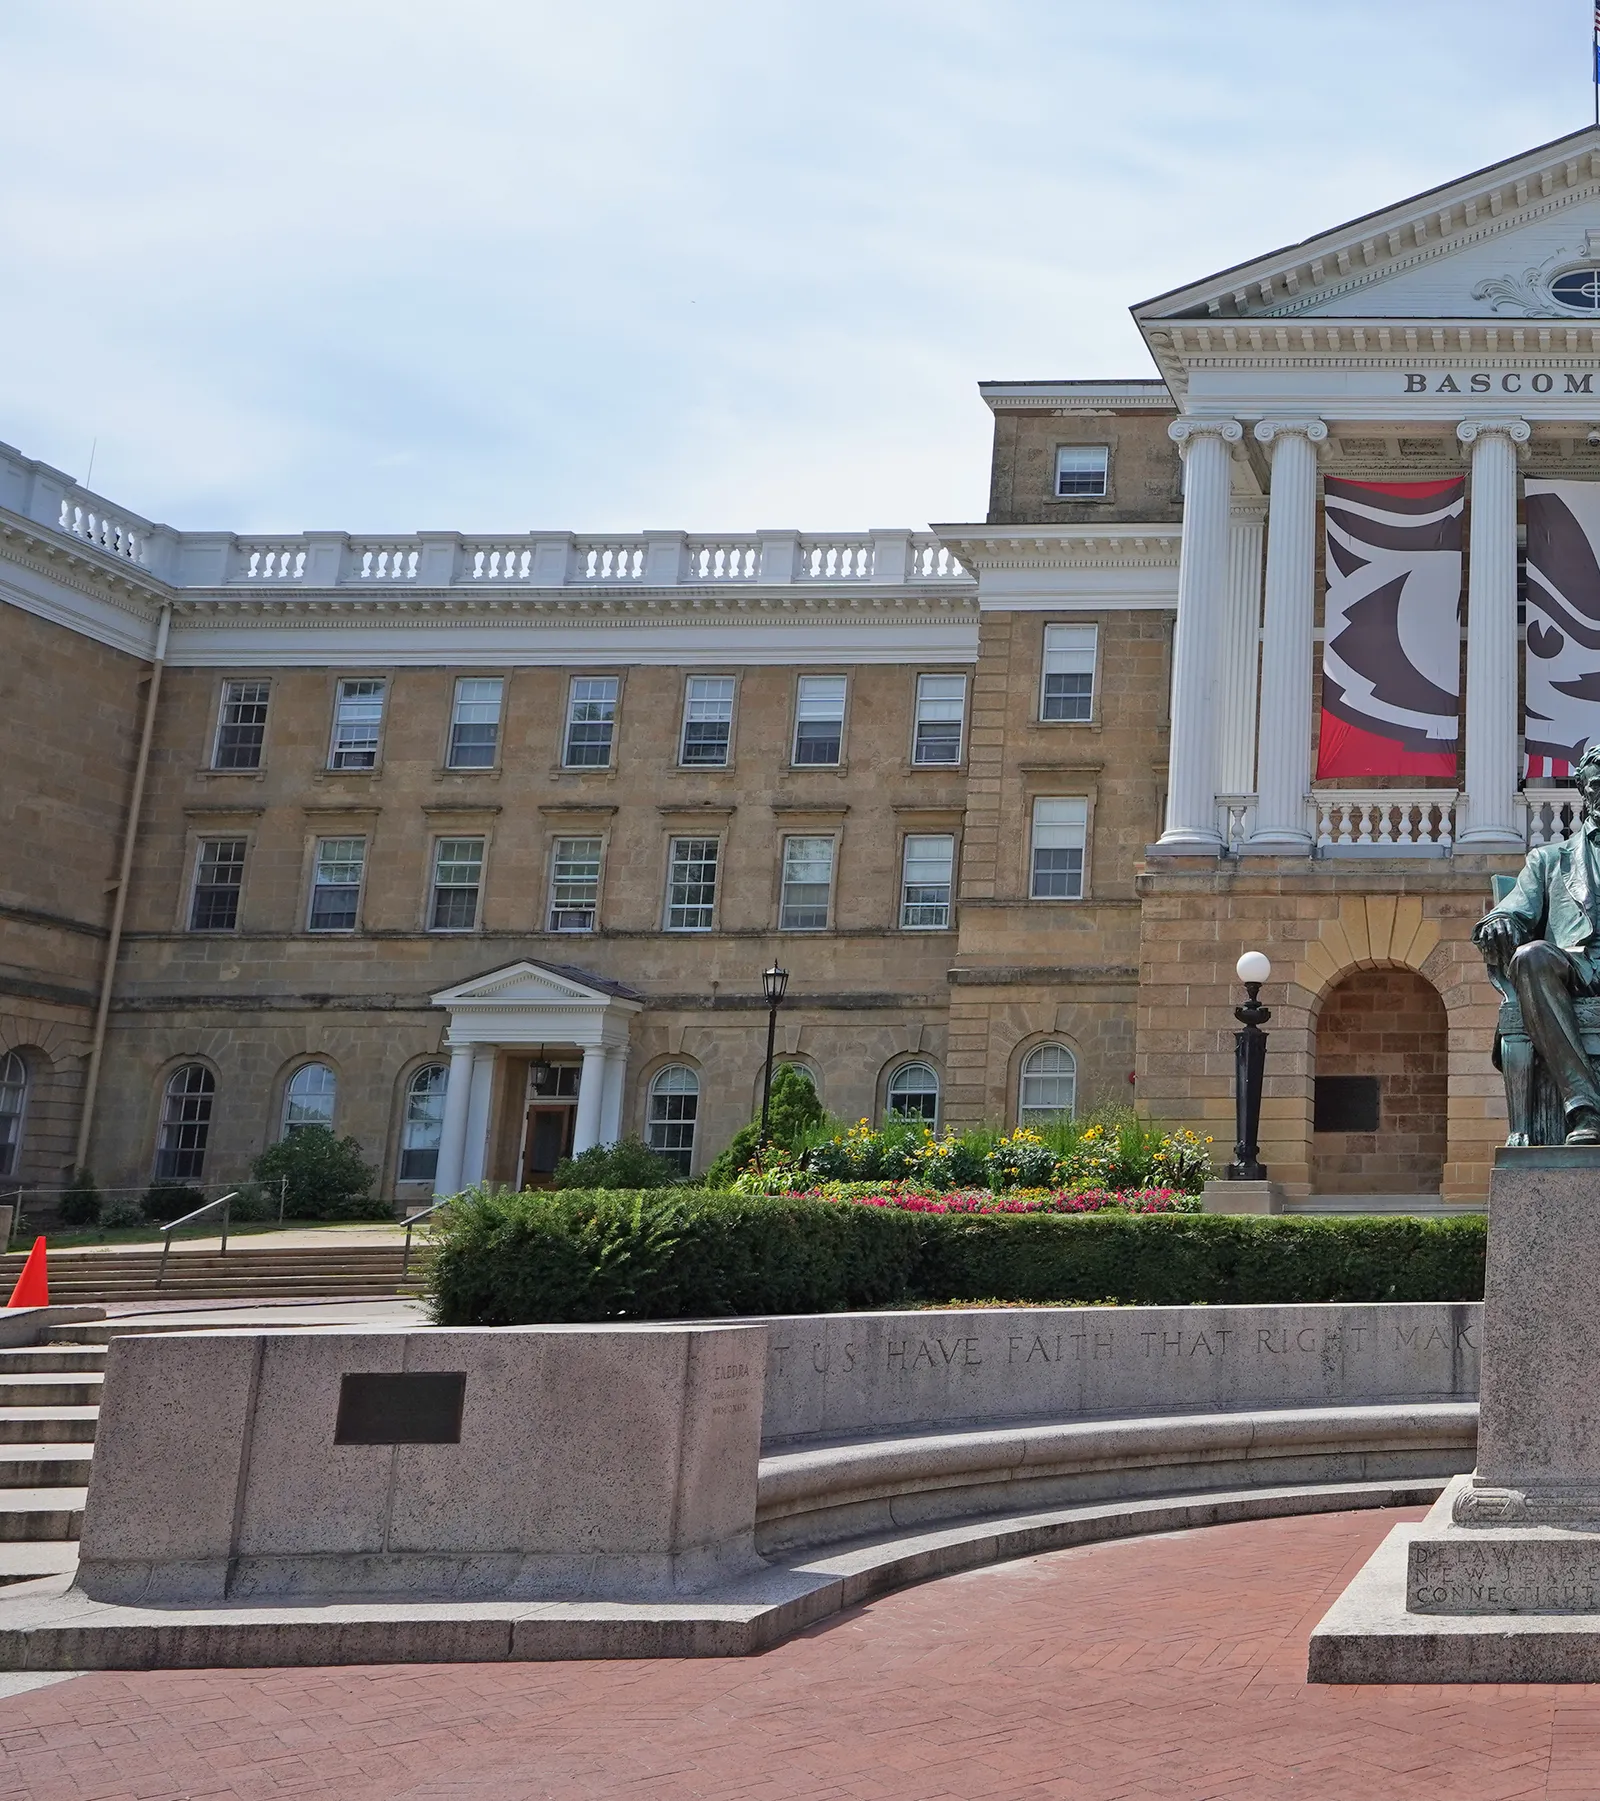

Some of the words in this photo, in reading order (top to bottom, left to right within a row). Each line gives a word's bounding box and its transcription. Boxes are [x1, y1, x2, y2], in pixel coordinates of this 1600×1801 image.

[1403, 373, 1594, 393] BASCOM
[812, 1342, 856, 1374] US
[887, 1337, 982, 1371] HAVE
[1008, 1333, 1114, 1364] FAITH
[1141, 1329, 1232, 1358] THAT
[1257, 1327, 1368, 1354] RIGHT
[1395, 1325, 1479, 1351] MAK
[1415, 1547, 1570, 1565] DELAWARE
[1415, 1567, 1486, 1583] NEW
[1417, 1586, 1593, 1603] CONNECTICUT
